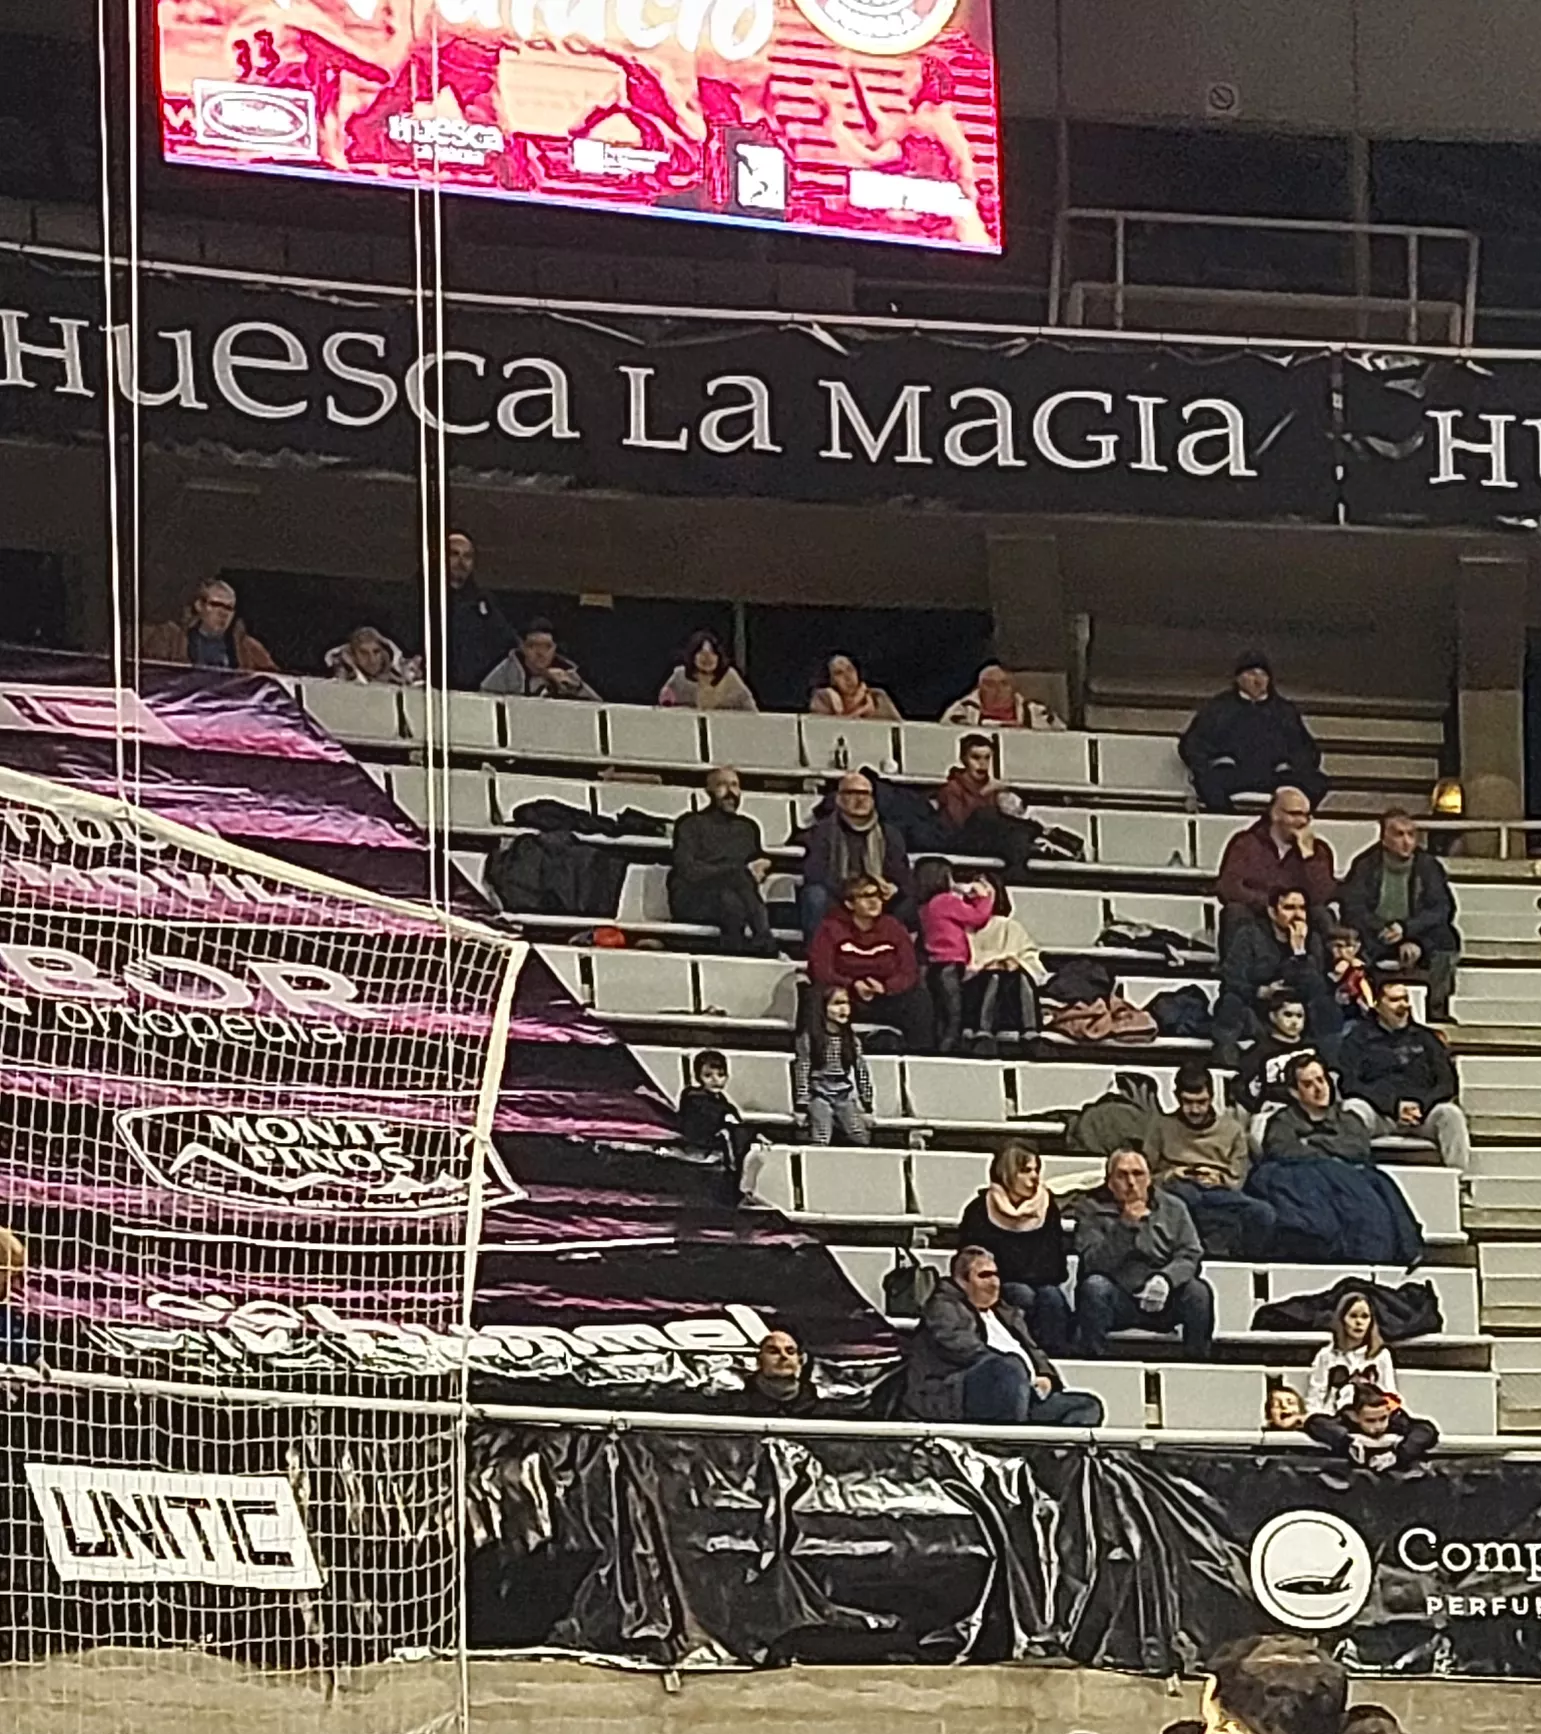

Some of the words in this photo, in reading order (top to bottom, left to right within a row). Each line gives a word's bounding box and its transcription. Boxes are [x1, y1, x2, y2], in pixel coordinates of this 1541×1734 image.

[617, 365, 783, 454] La
[57, 1000, 347, 1047] ortopedia
[208, 1113, 397, 1147] MONTE
